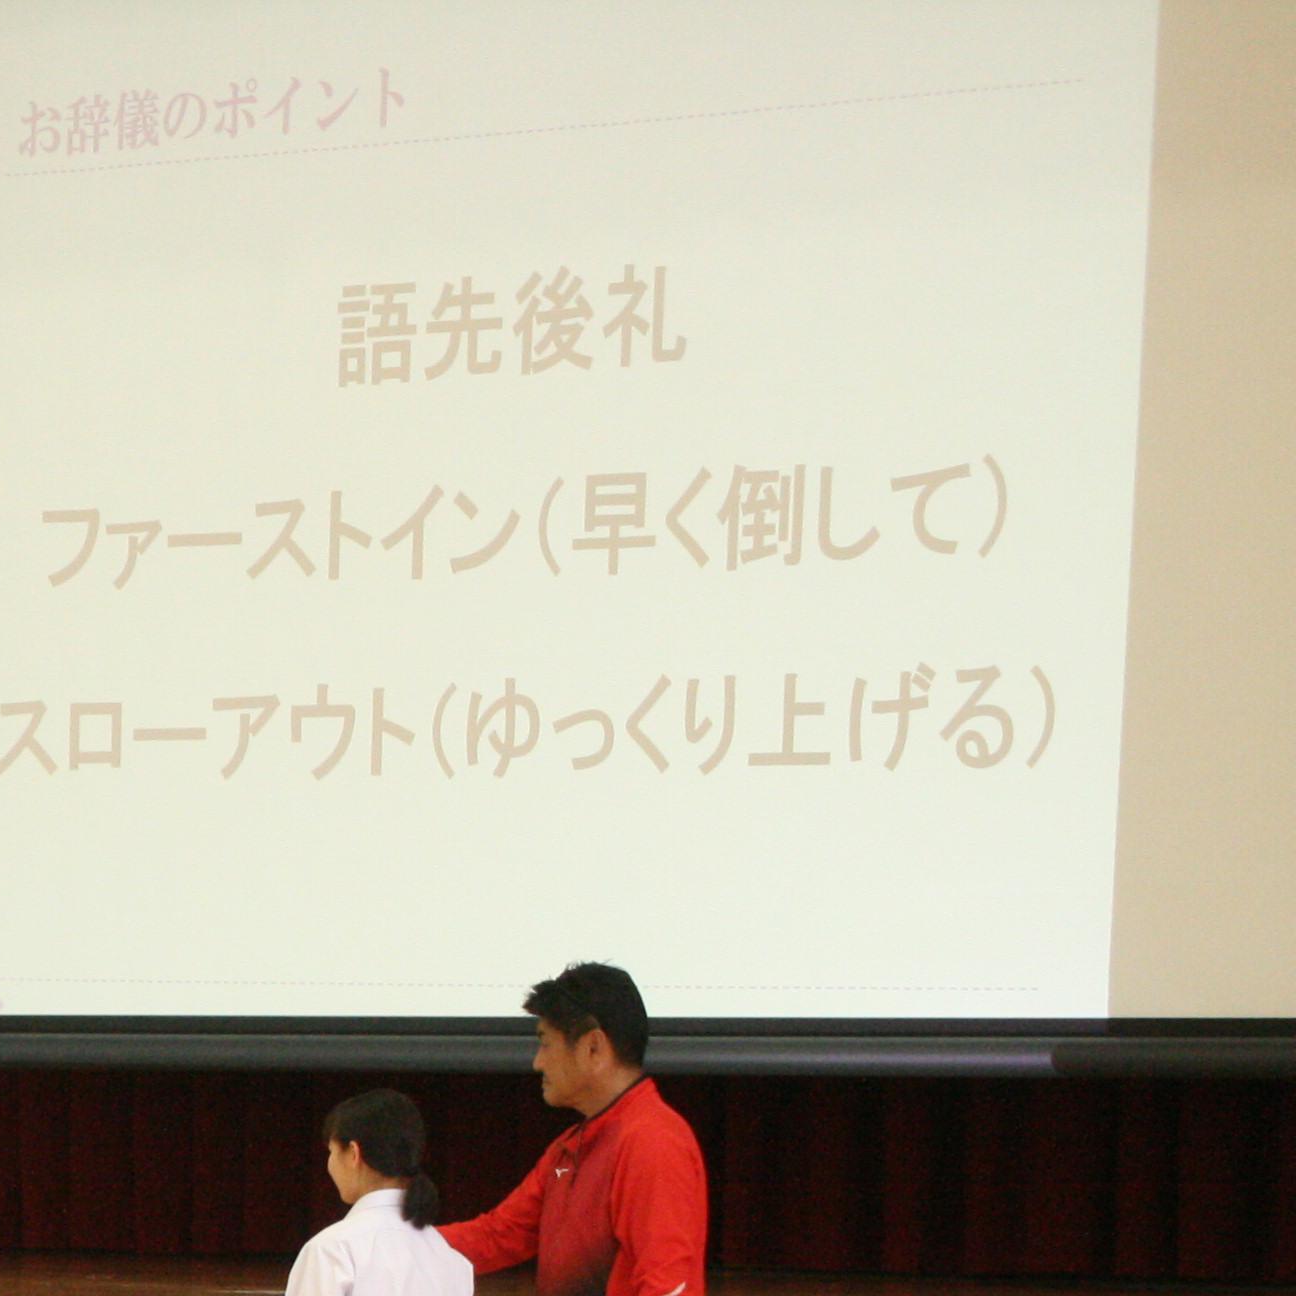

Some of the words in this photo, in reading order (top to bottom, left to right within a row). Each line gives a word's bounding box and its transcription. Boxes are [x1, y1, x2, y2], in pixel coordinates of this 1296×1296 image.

[16, 66, 407, 158] お辞儀のポイント
[337, 264, 687, 388] 語先後礼
